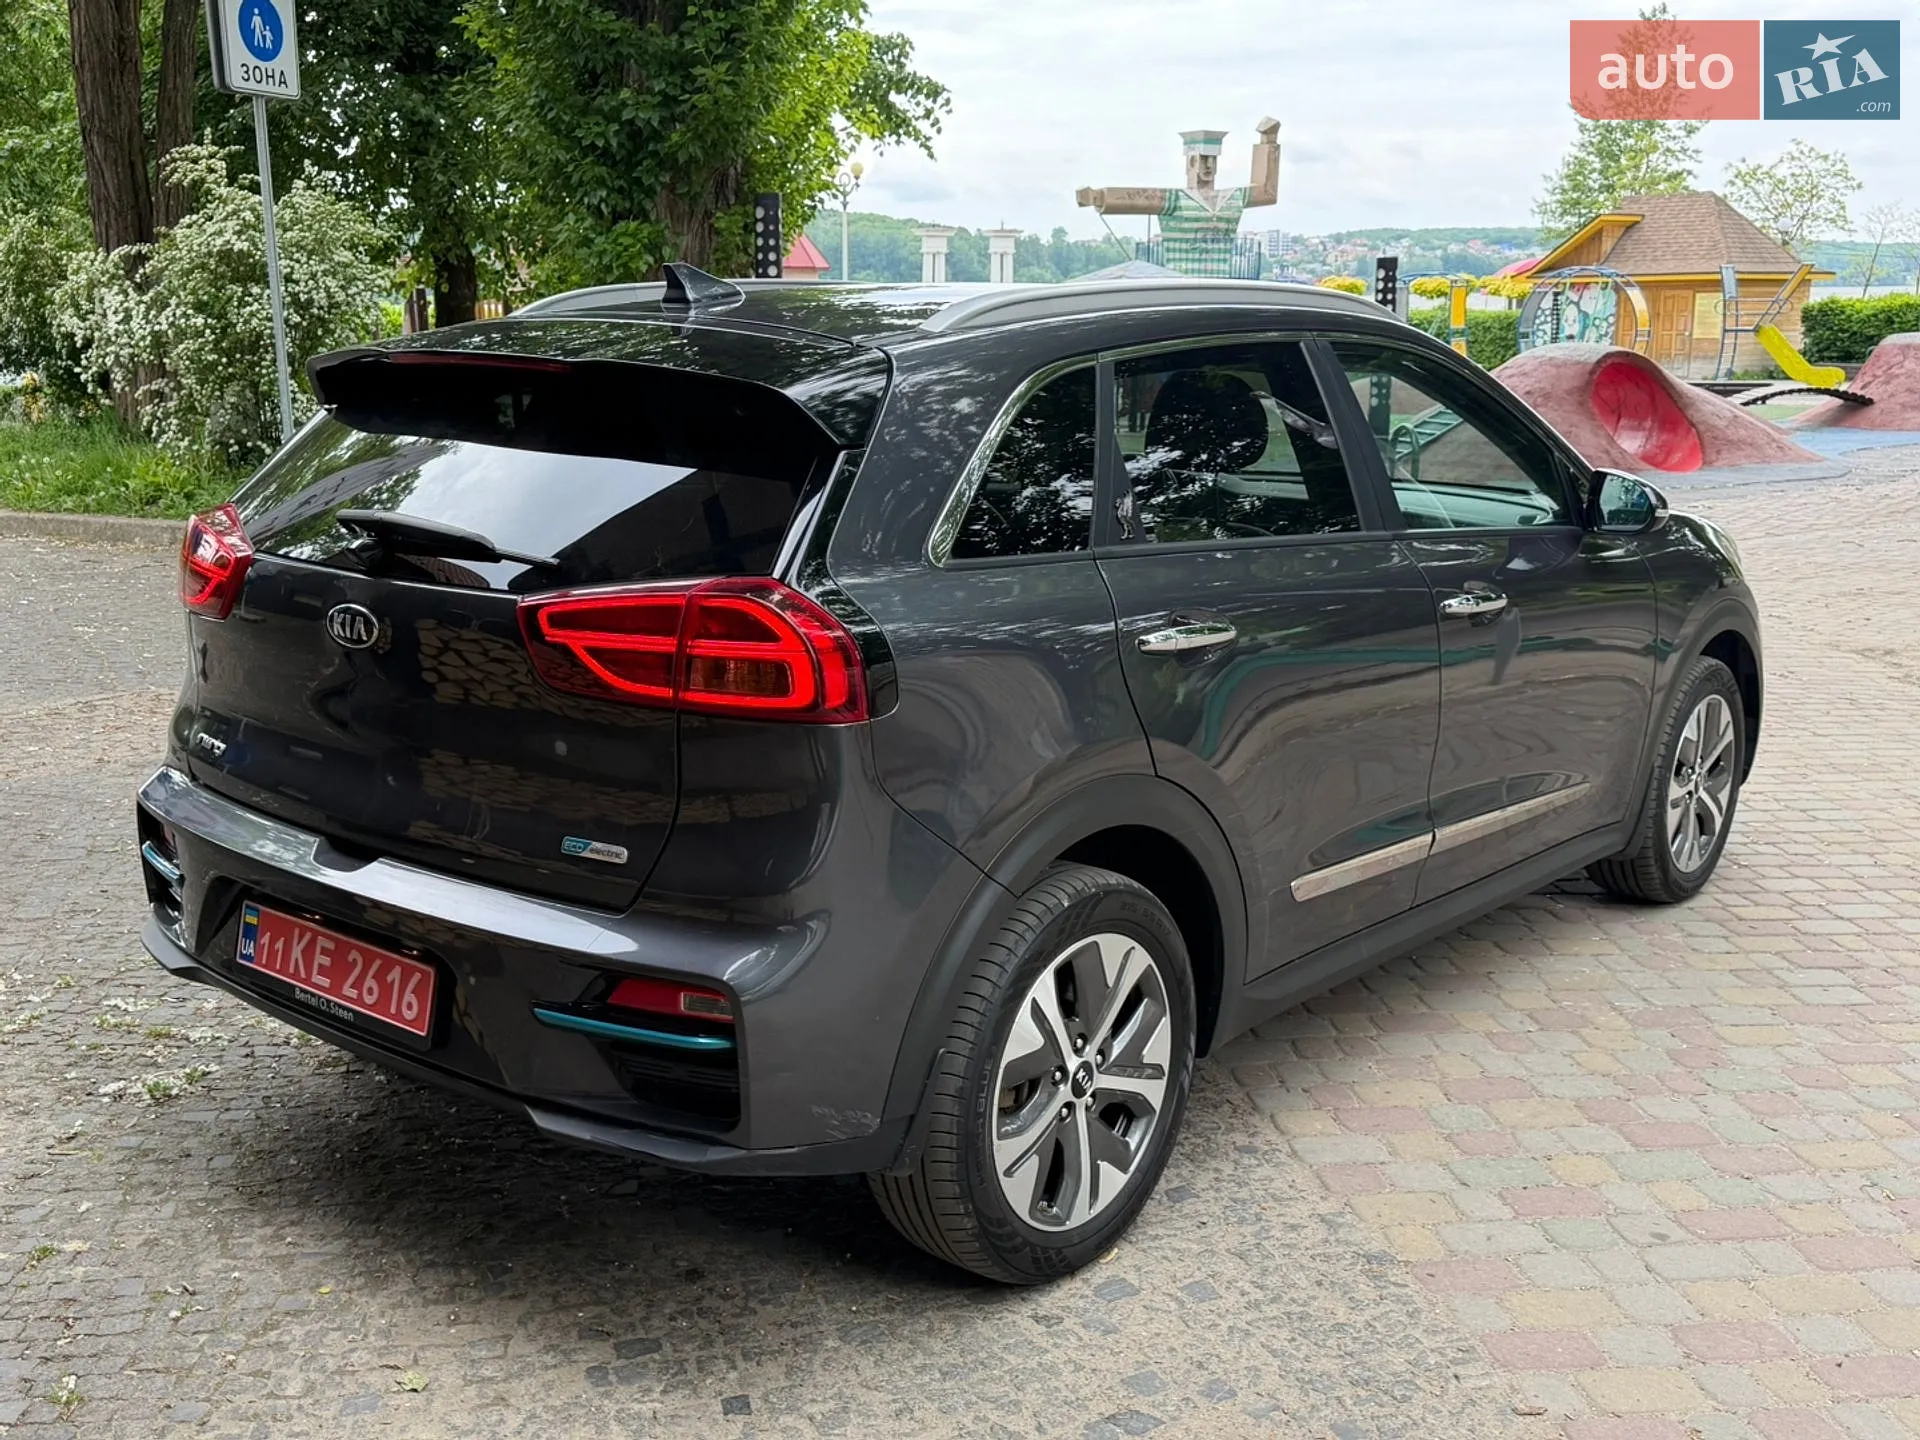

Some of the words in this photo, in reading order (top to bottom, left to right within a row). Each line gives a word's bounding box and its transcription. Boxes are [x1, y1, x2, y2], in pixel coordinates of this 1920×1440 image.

[240, 62, 289, 89] ЗОНА
[333, 611, 368, 641] KIA
[564, 841, 584, 852] ECO
[589, 846, 624, 860] electric
[241, 938, 255, 957] UA
[342, 951, 421, 1021] 2616
[294, 987, 318, 1007] Bertel
[330, 1002, 354, 1021] Steen
[976, 1056, 994, 1112] BLUE
[1076, 1068, 1092, 1089] KIA
